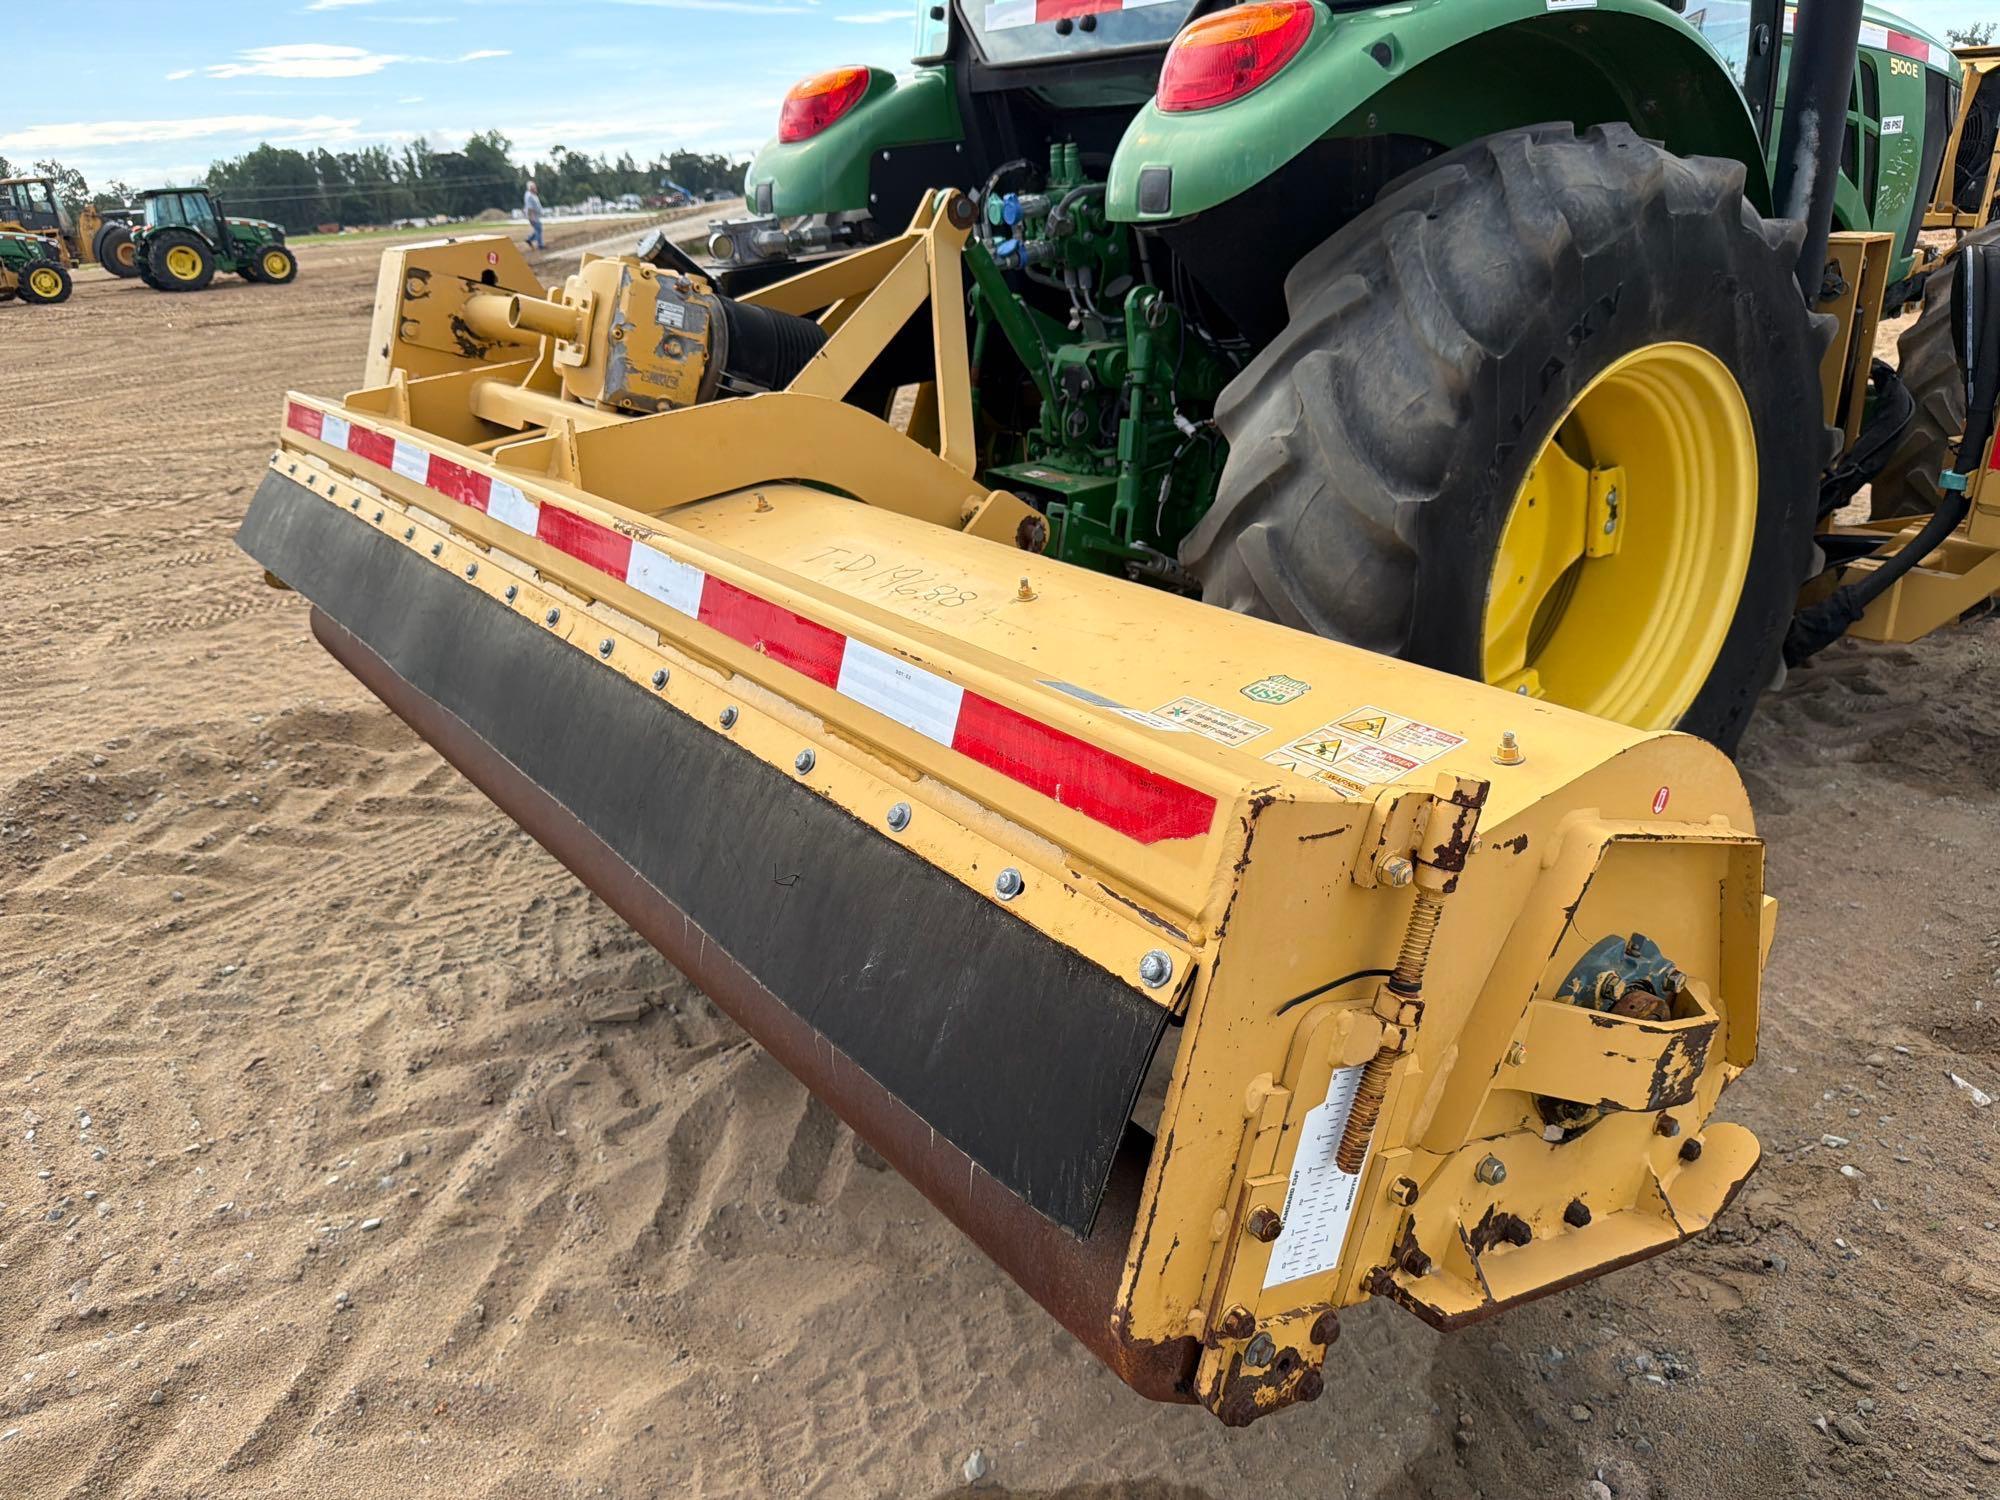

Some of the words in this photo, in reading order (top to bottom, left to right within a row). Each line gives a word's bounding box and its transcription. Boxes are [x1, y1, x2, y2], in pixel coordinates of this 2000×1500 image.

[1892, 119, 1902, 130] PSI
[1248, 686, 1286, 702] USA
[1292, 1170, 1300, 1186] CUT
[1345, 1176, 1358, 1211] SMOOTH
